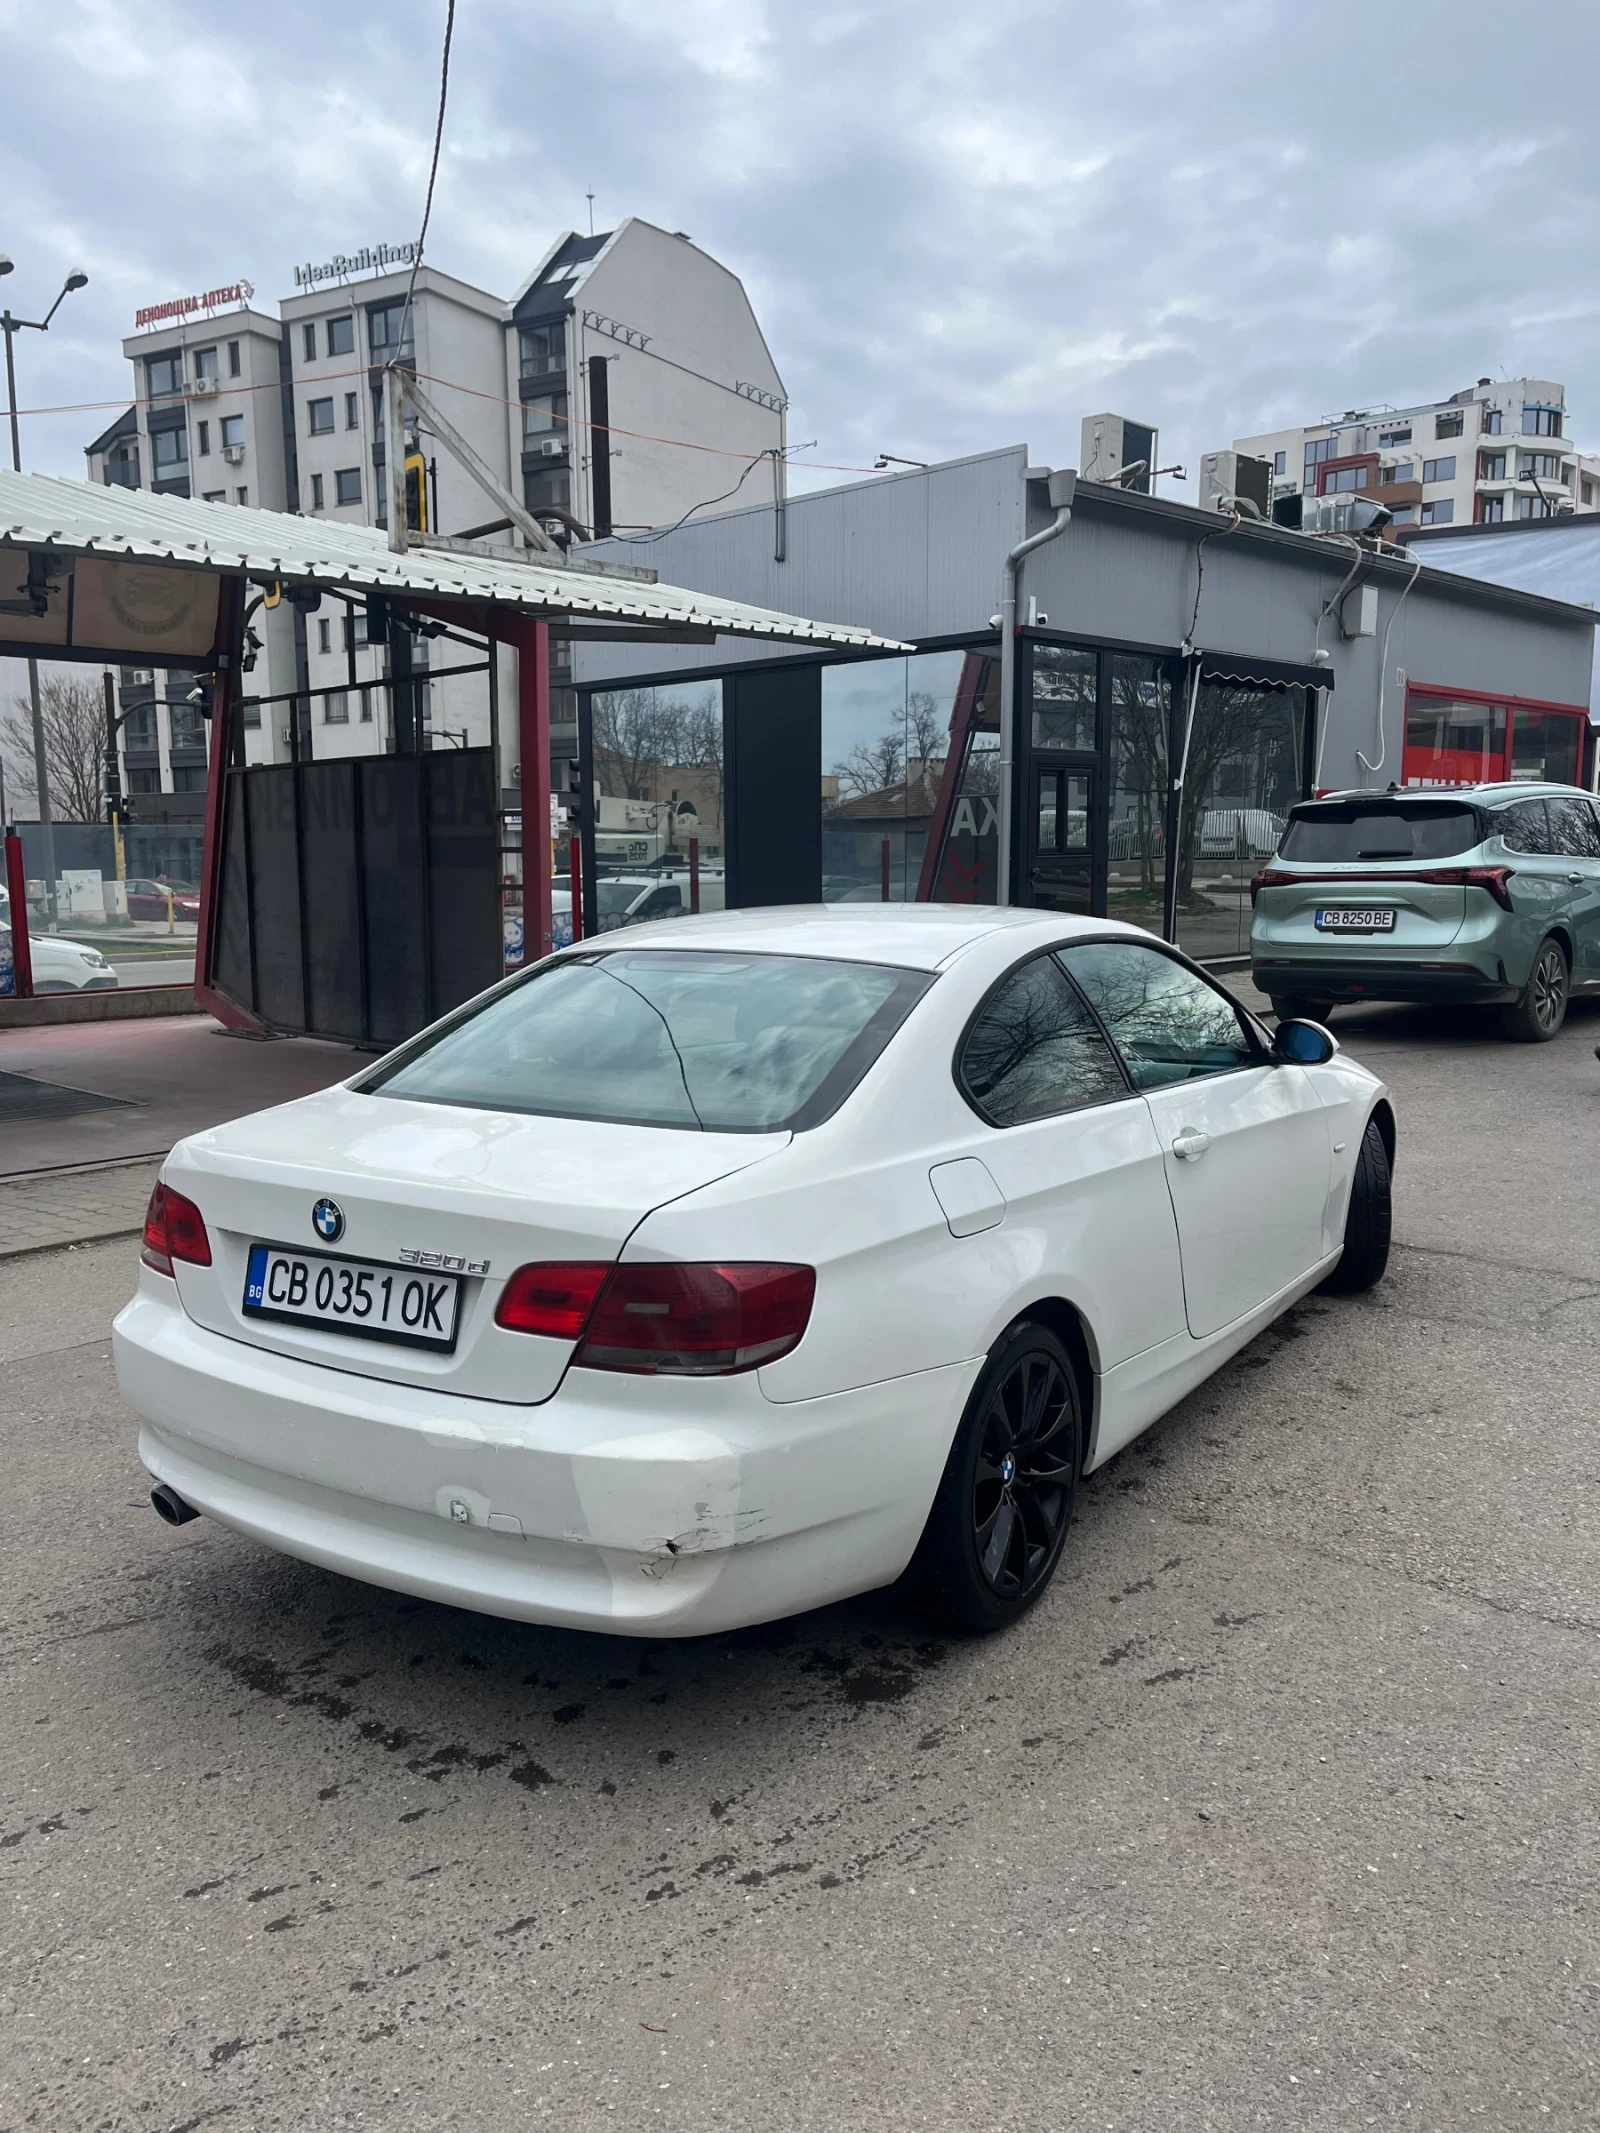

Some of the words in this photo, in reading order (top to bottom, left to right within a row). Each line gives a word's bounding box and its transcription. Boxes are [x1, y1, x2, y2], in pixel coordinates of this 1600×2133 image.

[293, 240, 424, 286] IdeaBuildings
[135, 295, 199, 328] ДЕНОНОЩНА
[201, 284, 243, 309] АПТЕКА
[1323, 911, 1340, 925] CB
[1342, 911, 1372, 925] 8250
[1373, 912, 1391, 926] BE
[398, 1247, 491, 1275] 320d
[249, 1284, 262, 1299] BG
[268, 1259, 309, 1306] CB
[315, 1266, 394, 1322] 0351
[401, 1280, 449, 1332] OK
